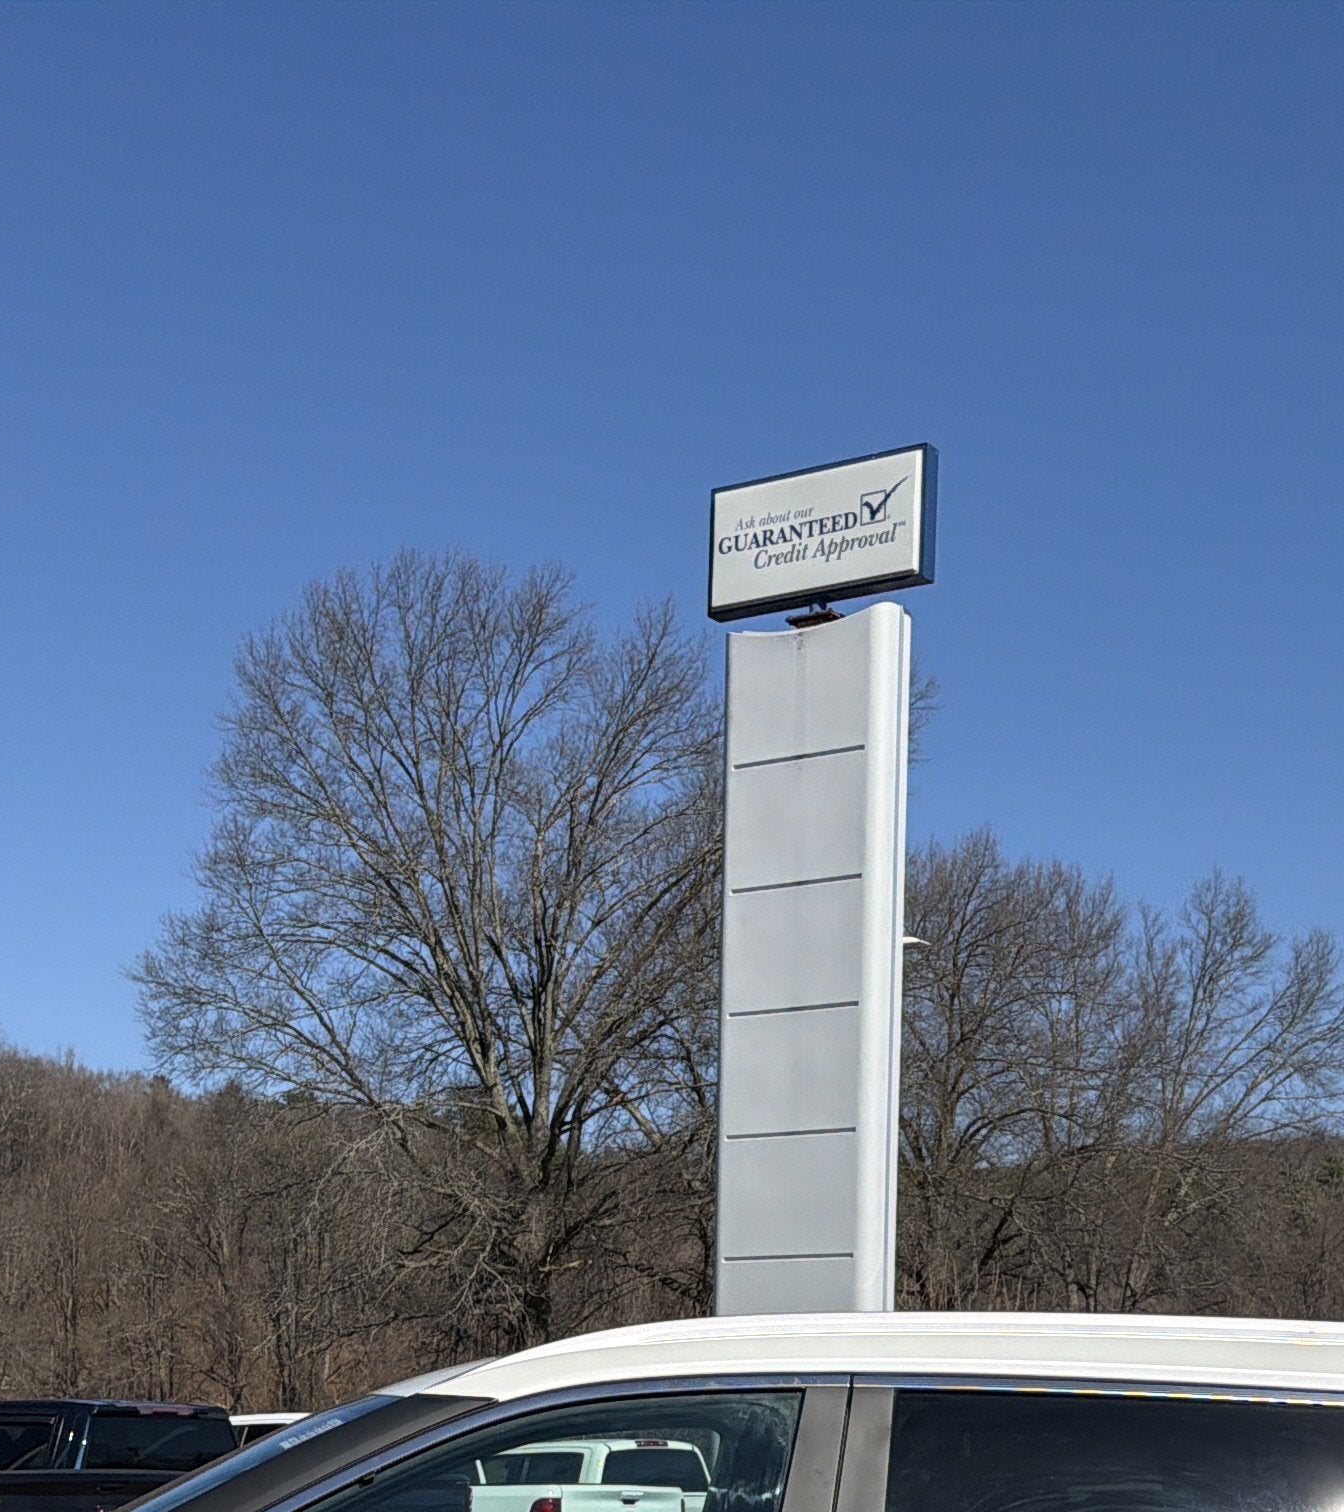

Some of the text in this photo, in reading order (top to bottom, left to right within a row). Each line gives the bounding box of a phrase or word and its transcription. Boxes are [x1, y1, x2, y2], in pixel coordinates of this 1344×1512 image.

[718, 511, 857, 555] GUARANTEED
[735, 507, 814, 531] Ask about our
[753, 522, 897, 569] Credit Approval
